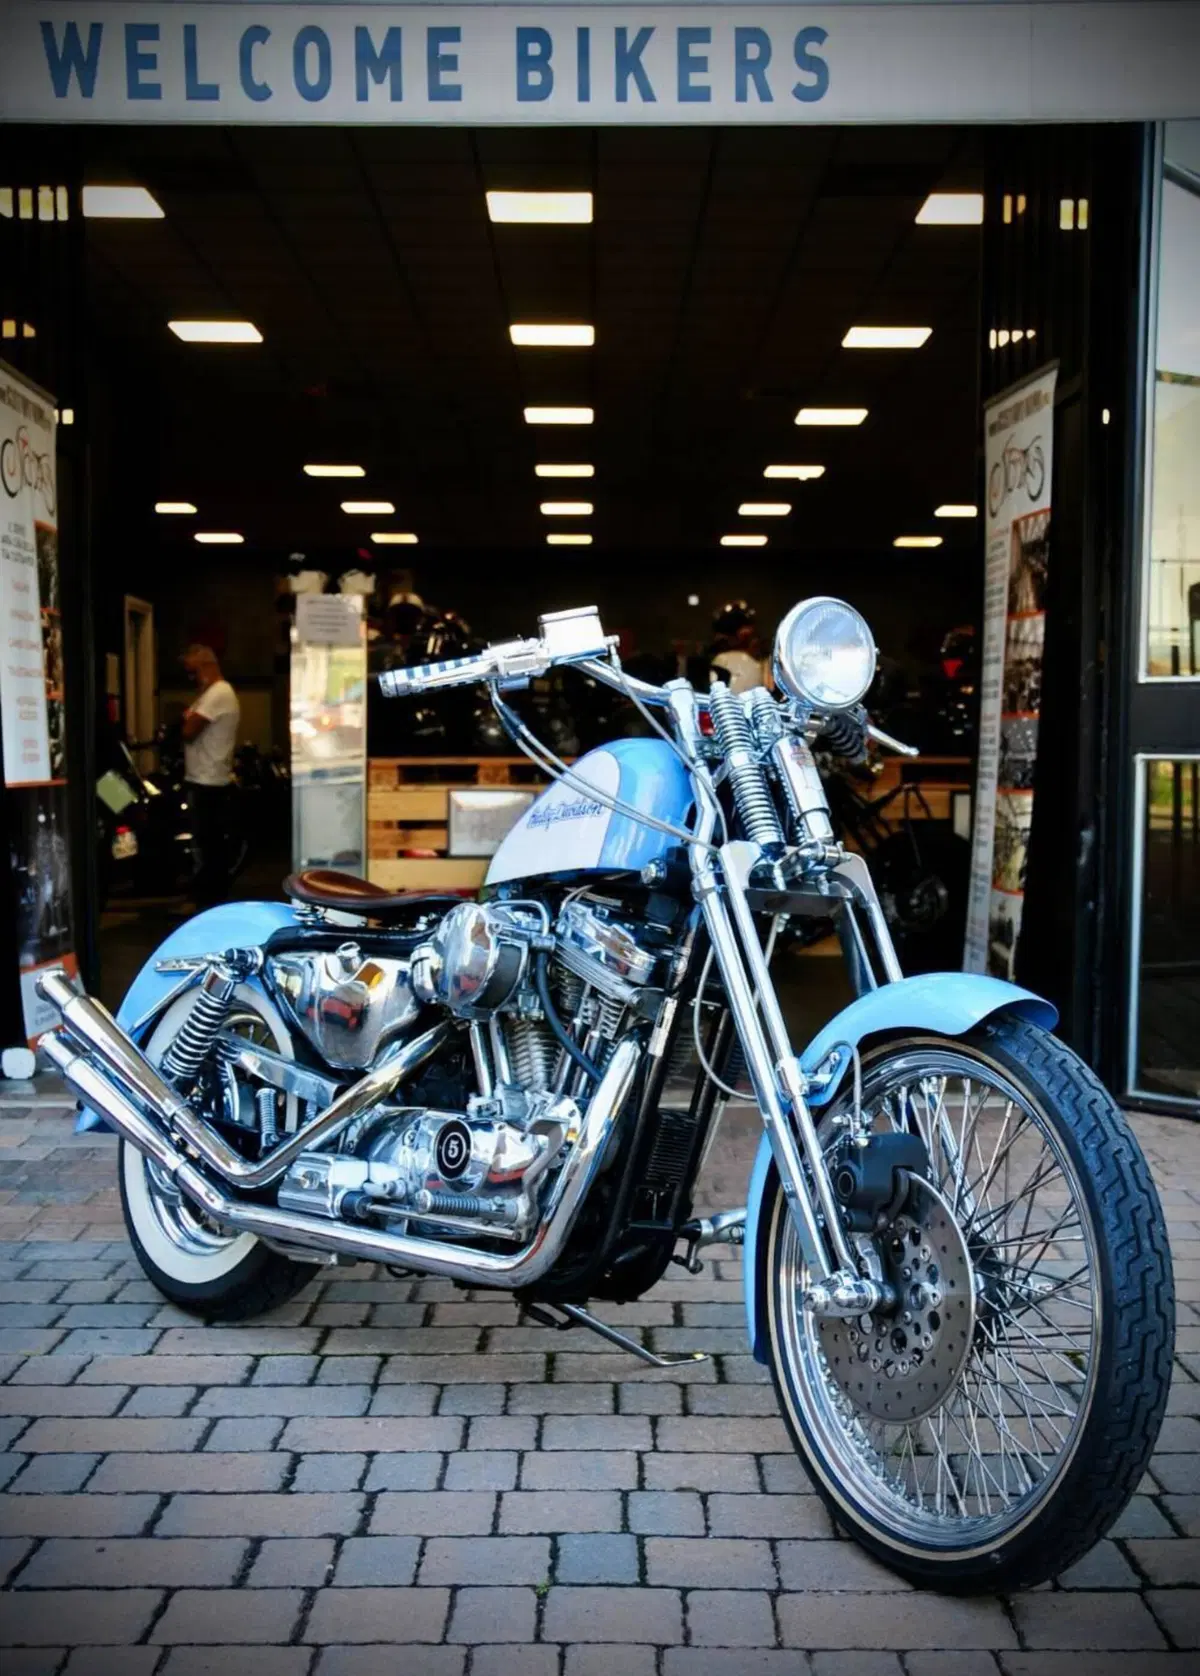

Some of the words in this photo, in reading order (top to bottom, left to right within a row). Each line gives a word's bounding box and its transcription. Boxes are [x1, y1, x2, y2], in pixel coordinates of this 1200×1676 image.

[40, 22, 461, 102] WELCOME
[516, 26, 830, 103] BIKERS
[448, 1140, 459, 1158] 5
